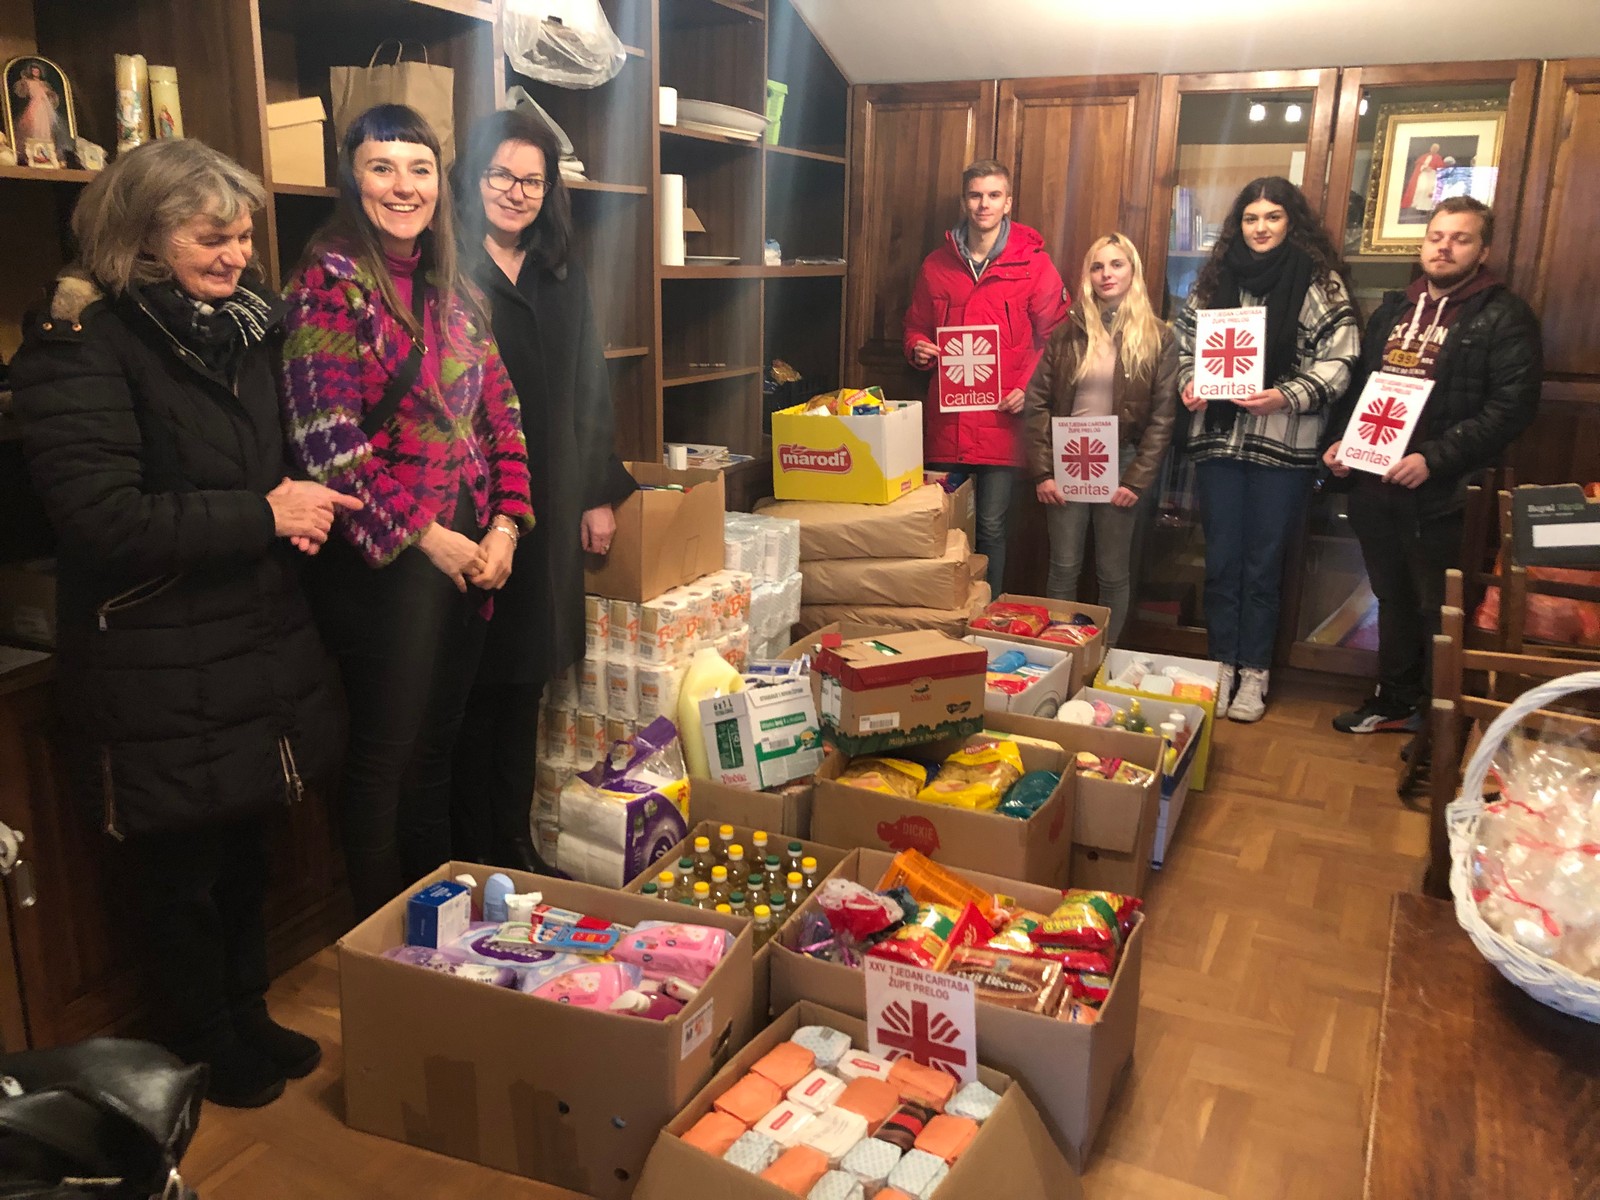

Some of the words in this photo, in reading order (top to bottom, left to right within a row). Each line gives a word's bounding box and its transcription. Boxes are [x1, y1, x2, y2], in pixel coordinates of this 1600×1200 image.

[944, 389, 996, 406] caritas
[1200, 381, 1256, 396] caritas
[783, 451, 847, 467] marodi
[1345, 447, 1391, 467] caritas
[1062, 483, 1110, 496] caritas
[902, 822, 934, 841] DICKIE
[888, 976, 912, 992] ŽUPE
[913, 982, 950, 1000] PRELOG
[889, 965, 923, 981] TJEDAN
[925, 974, 970, 993] CARITASA
[984, 974, 1033, 993] Biscuits
